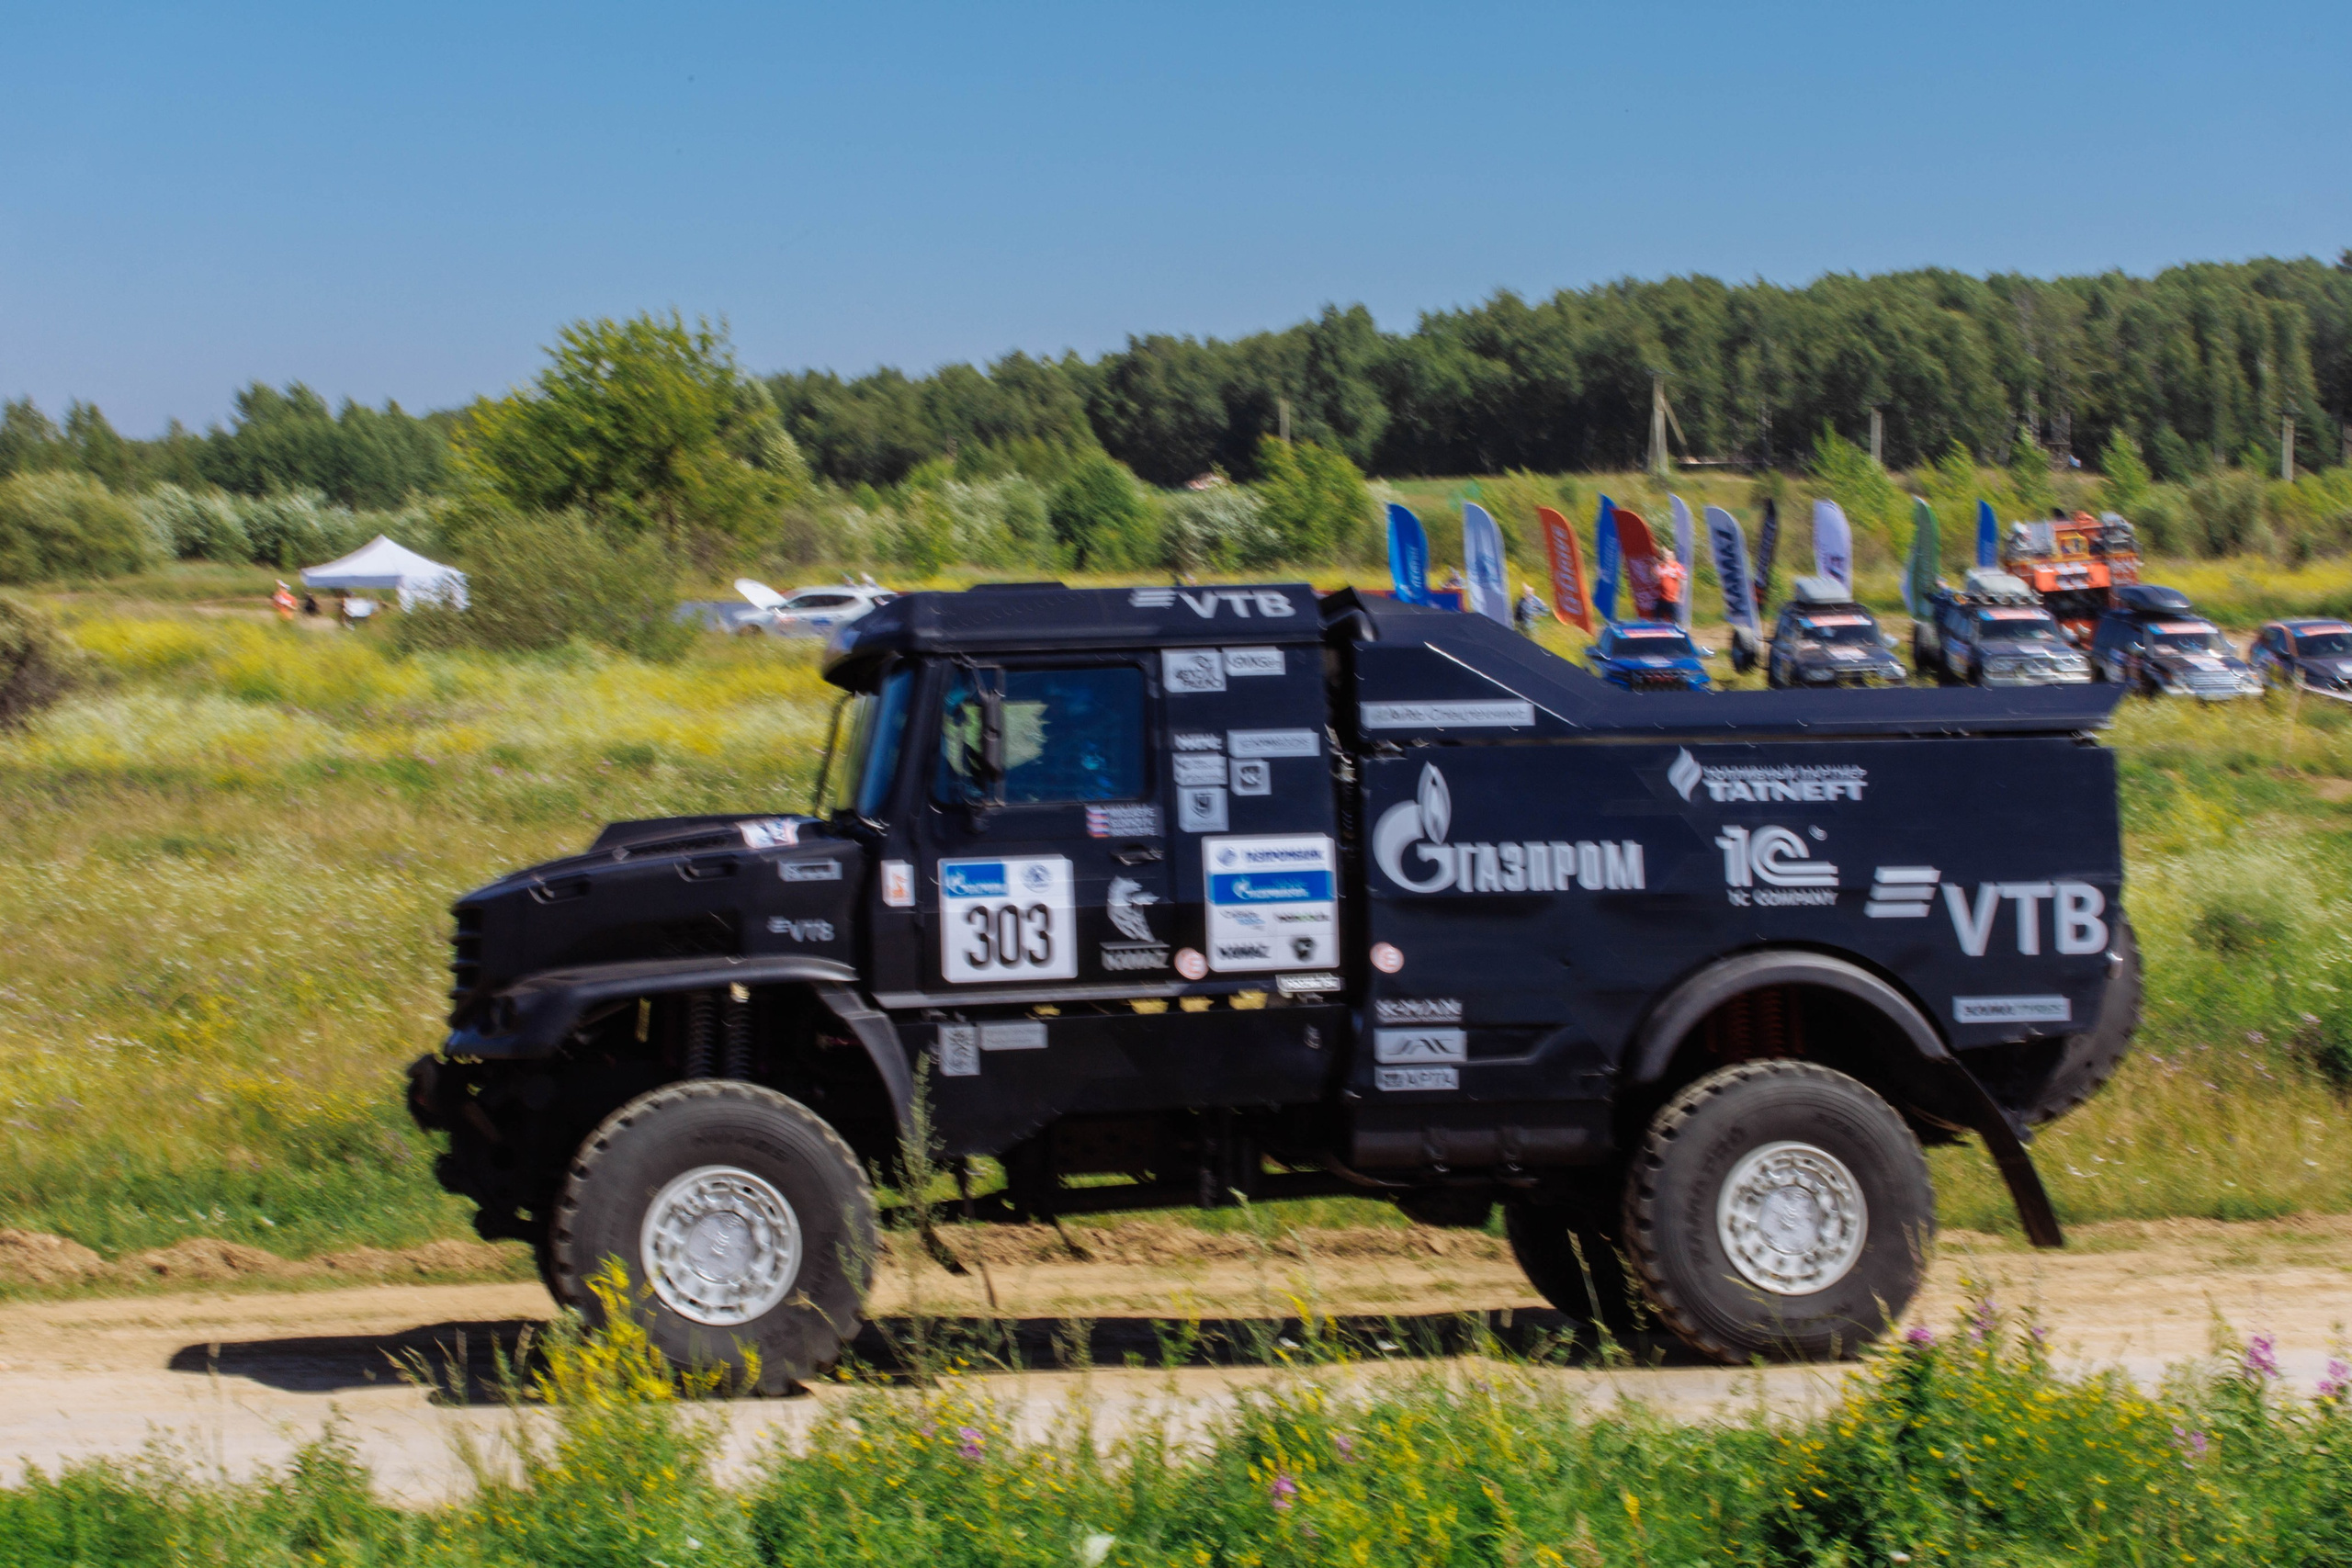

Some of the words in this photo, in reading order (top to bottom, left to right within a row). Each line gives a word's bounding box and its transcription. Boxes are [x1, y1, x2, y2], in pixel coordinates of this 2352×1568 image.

[1177, 589, 1296, 618] VTB
[1702, 779, 1869, 802] TATNEFT
[788, 919, 835, 942] VTB
[1939, 881, 2109, 956] VTB
[964, 903, 1057, 970] 303
